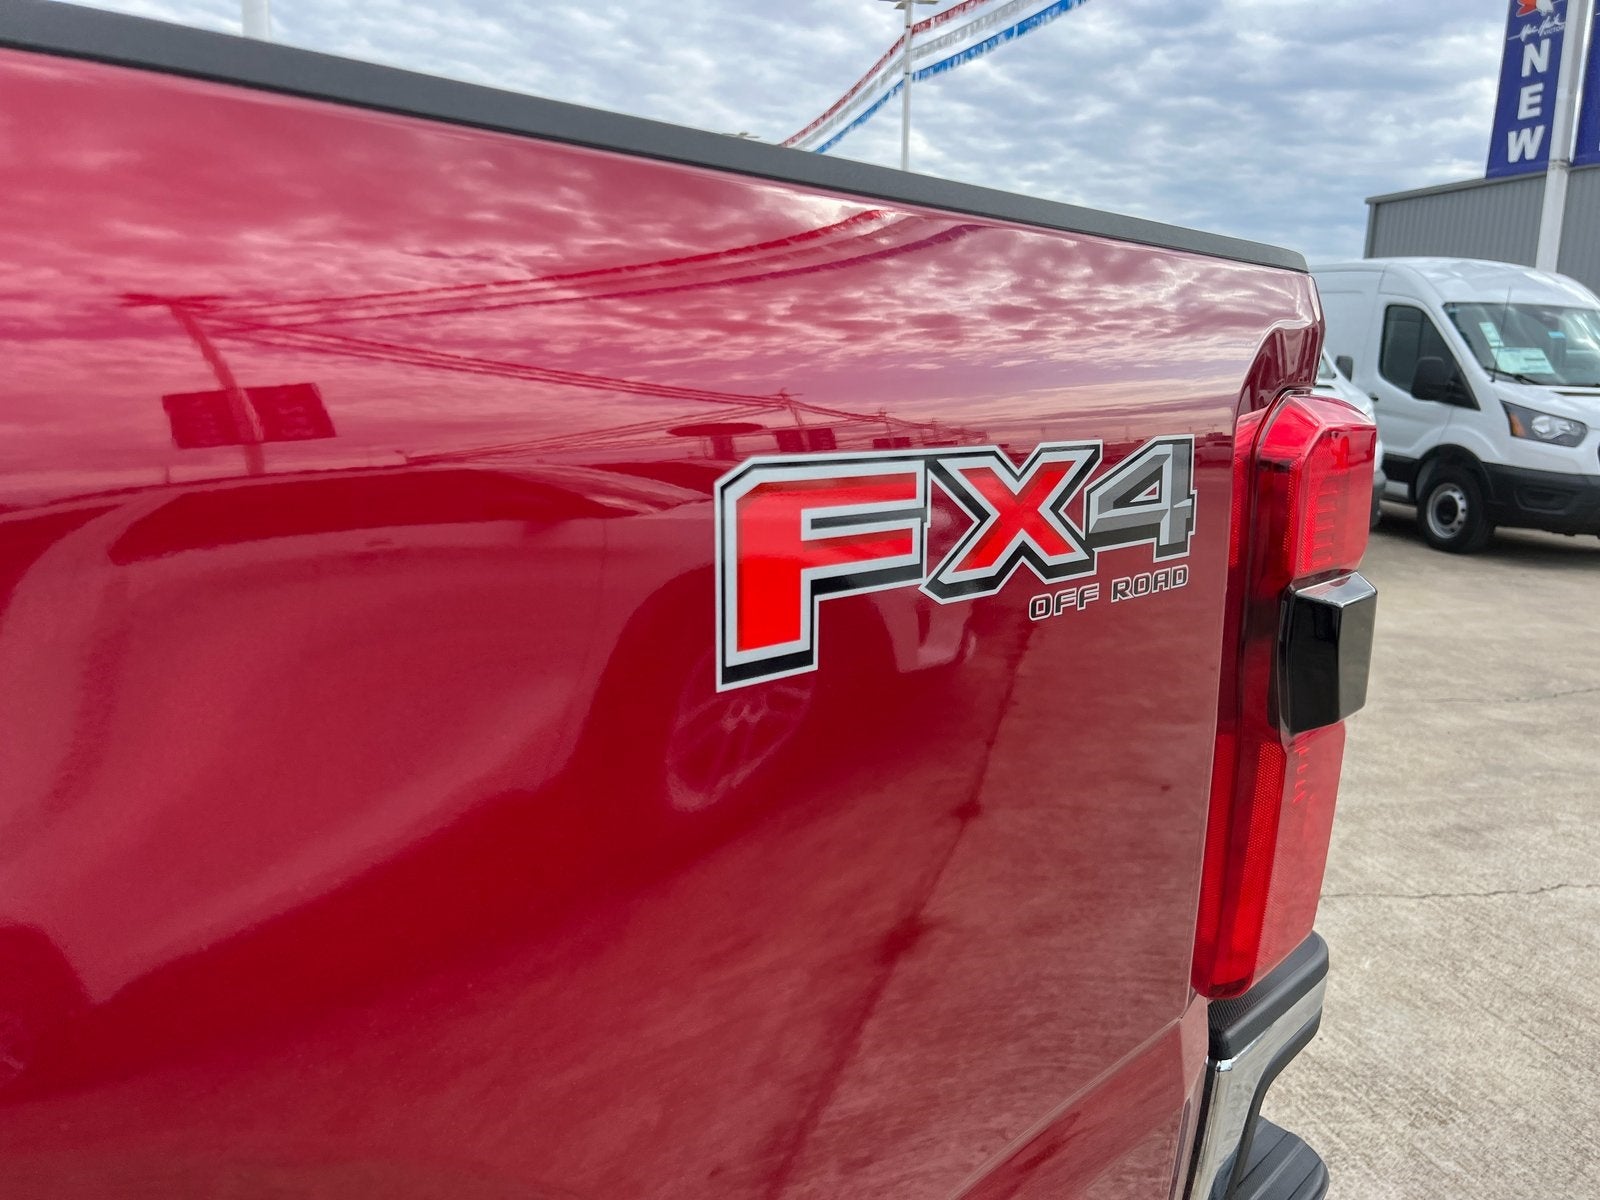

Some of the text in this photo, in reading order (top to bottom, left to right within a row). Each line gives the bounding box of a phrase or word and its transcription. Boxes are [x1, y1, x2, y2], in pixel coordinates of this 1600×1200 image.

[1507, 38, 1551, 163] NEW
[714, 434, 1198, 693] FX4
[1028, 564, 1189, 621] OFF ROAD
